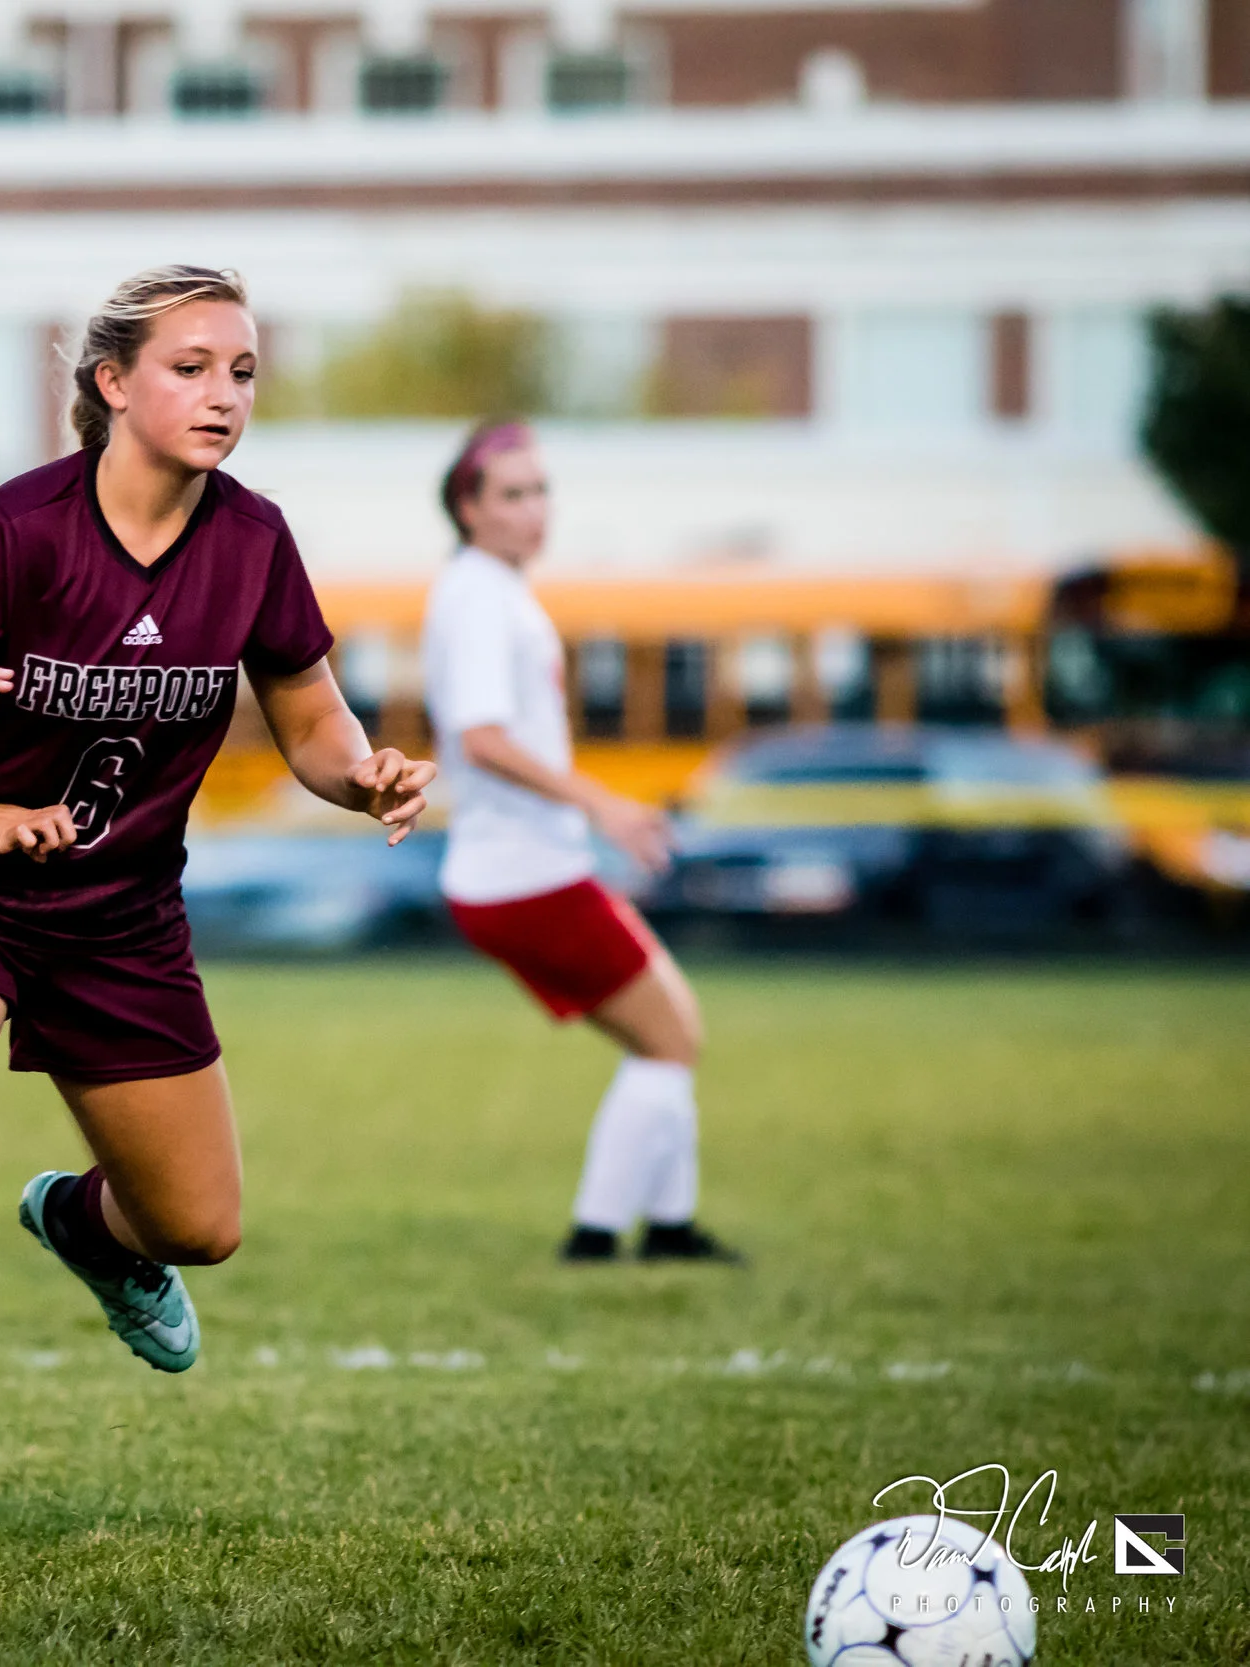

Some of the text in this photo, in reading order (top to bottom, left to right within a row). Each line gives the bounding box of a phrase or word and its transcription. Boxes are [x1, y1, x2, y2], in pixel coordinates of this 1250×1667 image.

[122, 632, 163, 646] adidas
[15, 653, 238, 722] FREEPORT
[59, 736, 146, 850] 6
